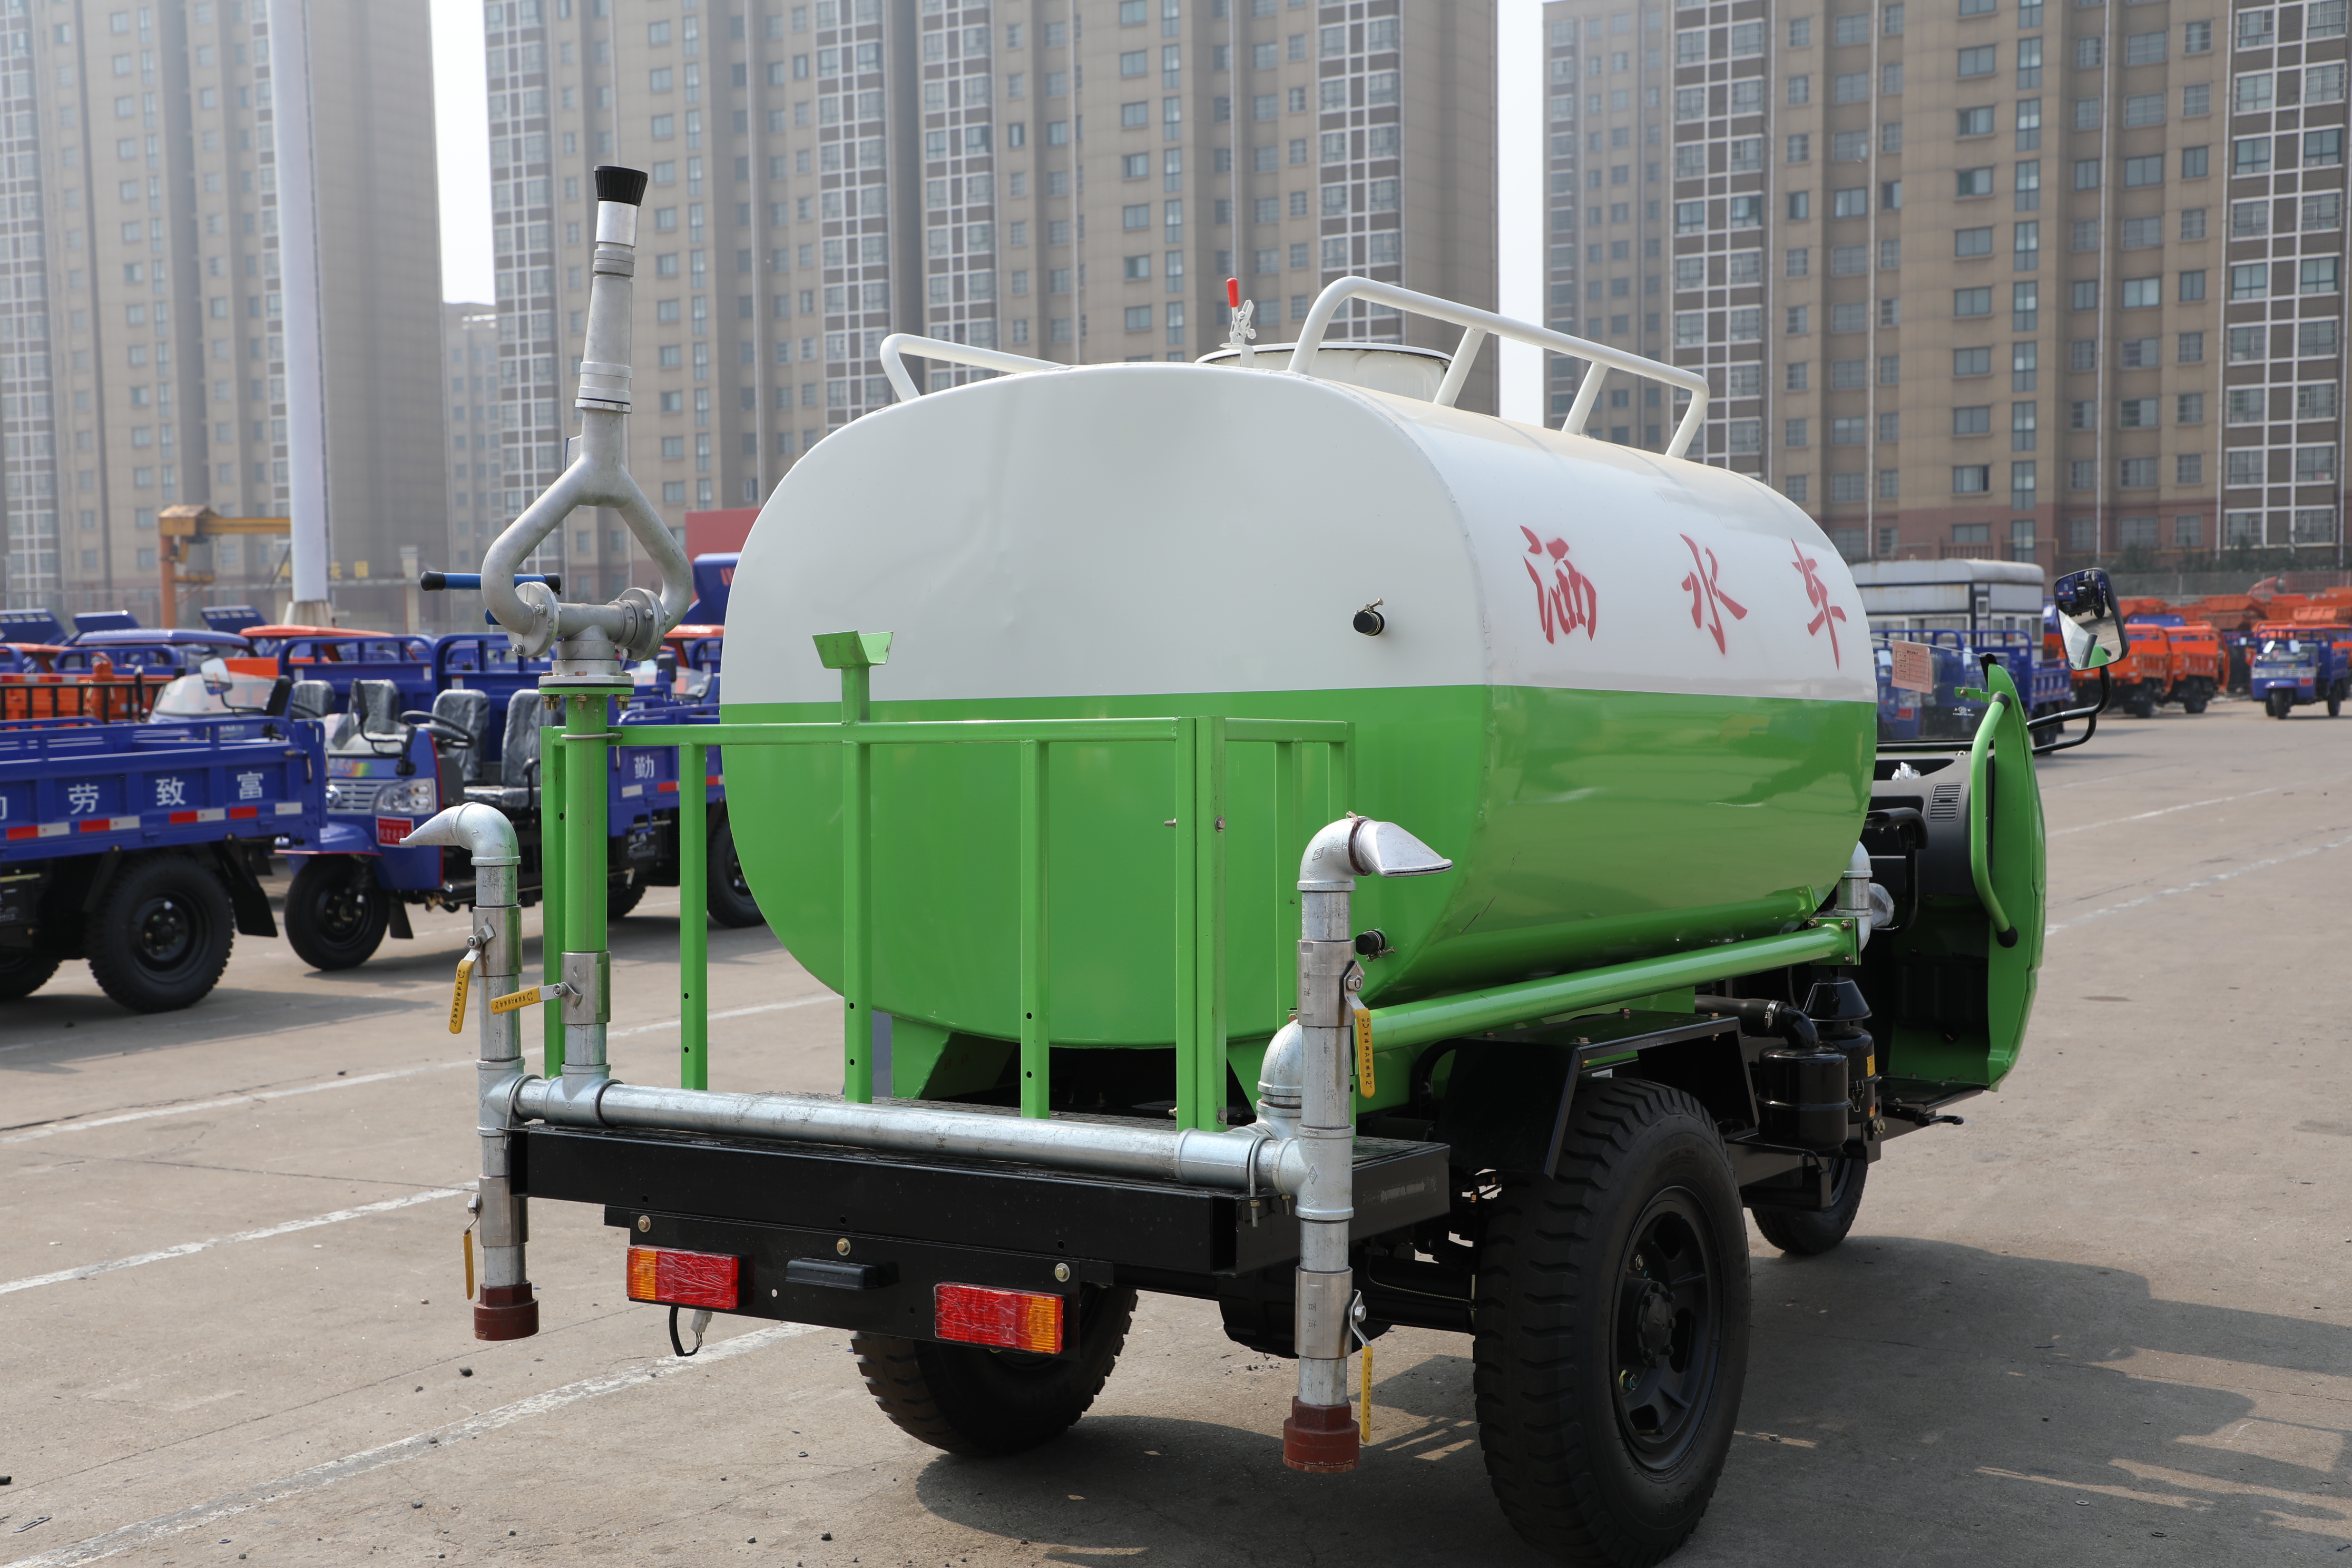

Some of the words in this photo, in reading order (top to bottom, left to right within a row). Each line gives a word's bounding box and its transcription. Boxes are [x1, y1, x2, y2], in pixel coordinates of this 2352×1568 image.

[1520, 525, 1847, 671] 洒水车
[634, 754, 655, 779] 勤
